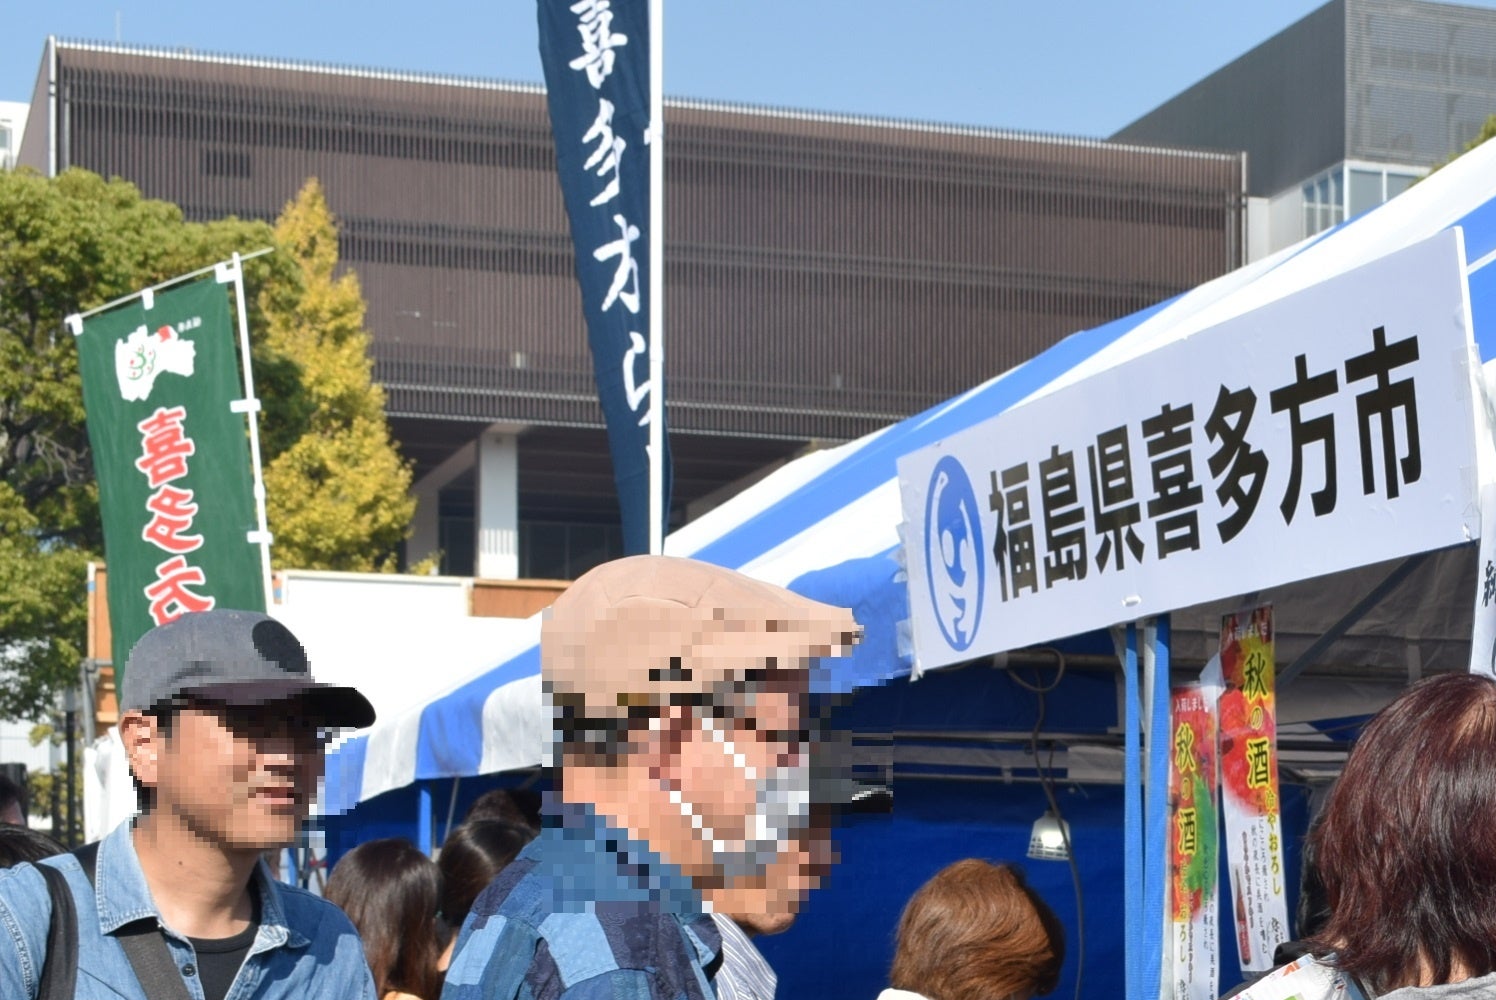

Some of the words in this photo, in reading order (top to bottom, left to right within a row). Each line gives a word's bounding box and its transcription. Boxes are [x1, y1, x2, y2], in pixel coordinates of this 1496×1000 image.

[987, 325, 1422, 603] 福島県喜多方市
[1244, 652, 1270, 786] 秋の酒
[1175, 723, 1197, 856] 秋の酒
